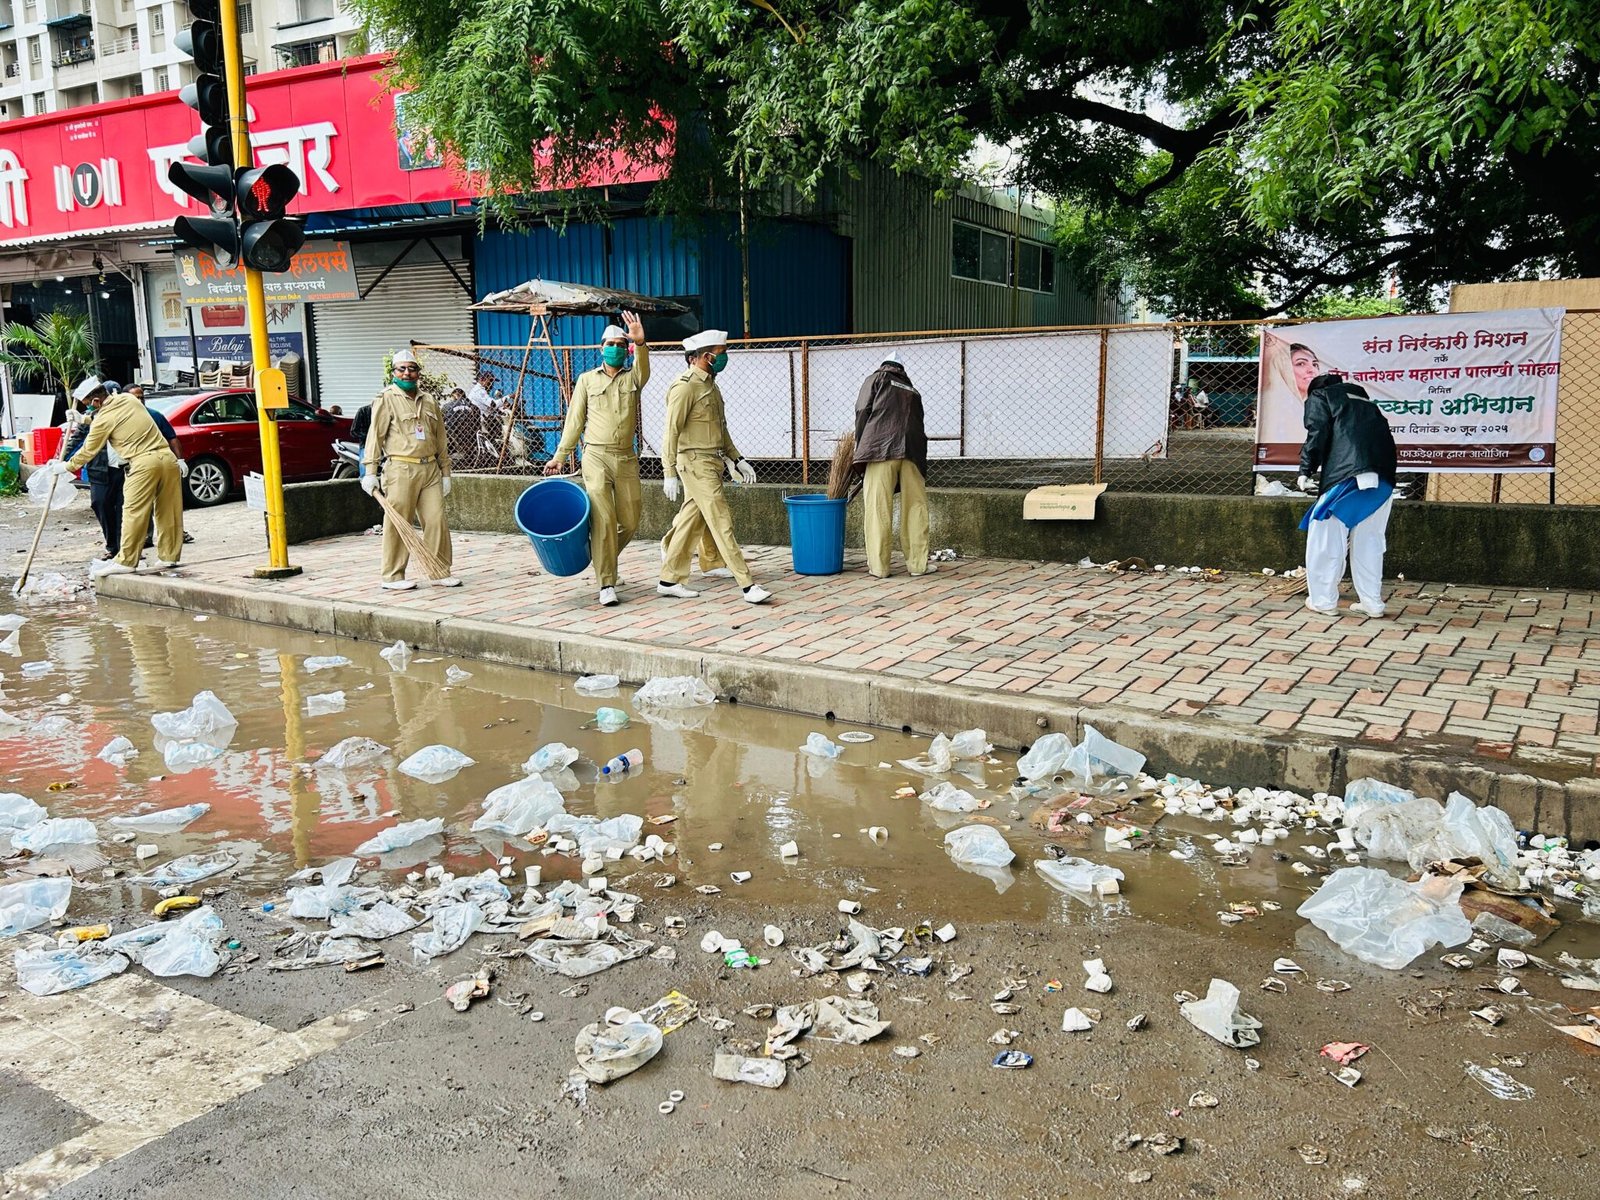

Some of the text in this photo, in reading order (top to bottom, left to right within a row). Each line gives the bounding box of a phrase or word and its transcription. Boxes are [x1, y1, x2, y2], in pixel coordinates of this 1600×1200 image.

[284, 277, 325, 291] सप्लायर्स
[208, 336, 246, 355] Balaji
[1363, 330, 1528, 354] संत निरंकारी मिशन
[1434, 354, 1448, 363] तर्फे
[1352, 366, 1405, 383] ज्ञानेश्वर
[1409, 367, 1461, 383] महाराज
[1465, 360, 1514, 379] पालखी
[1518, 359, 1560, 379] सोहळा
[1374, 393, 1535, 416] च्छता अभियान
[1409, 423, 1440, 434] दिनांक
[1444, 425, 1456, 433] २०
[1460, 425, 1477, 436] जून
[1481, 425, 1508, 433] २०२५
[1446, 450, 1466, 459] द्वारा
[1469, 447, 1509, 458] आयोजित
